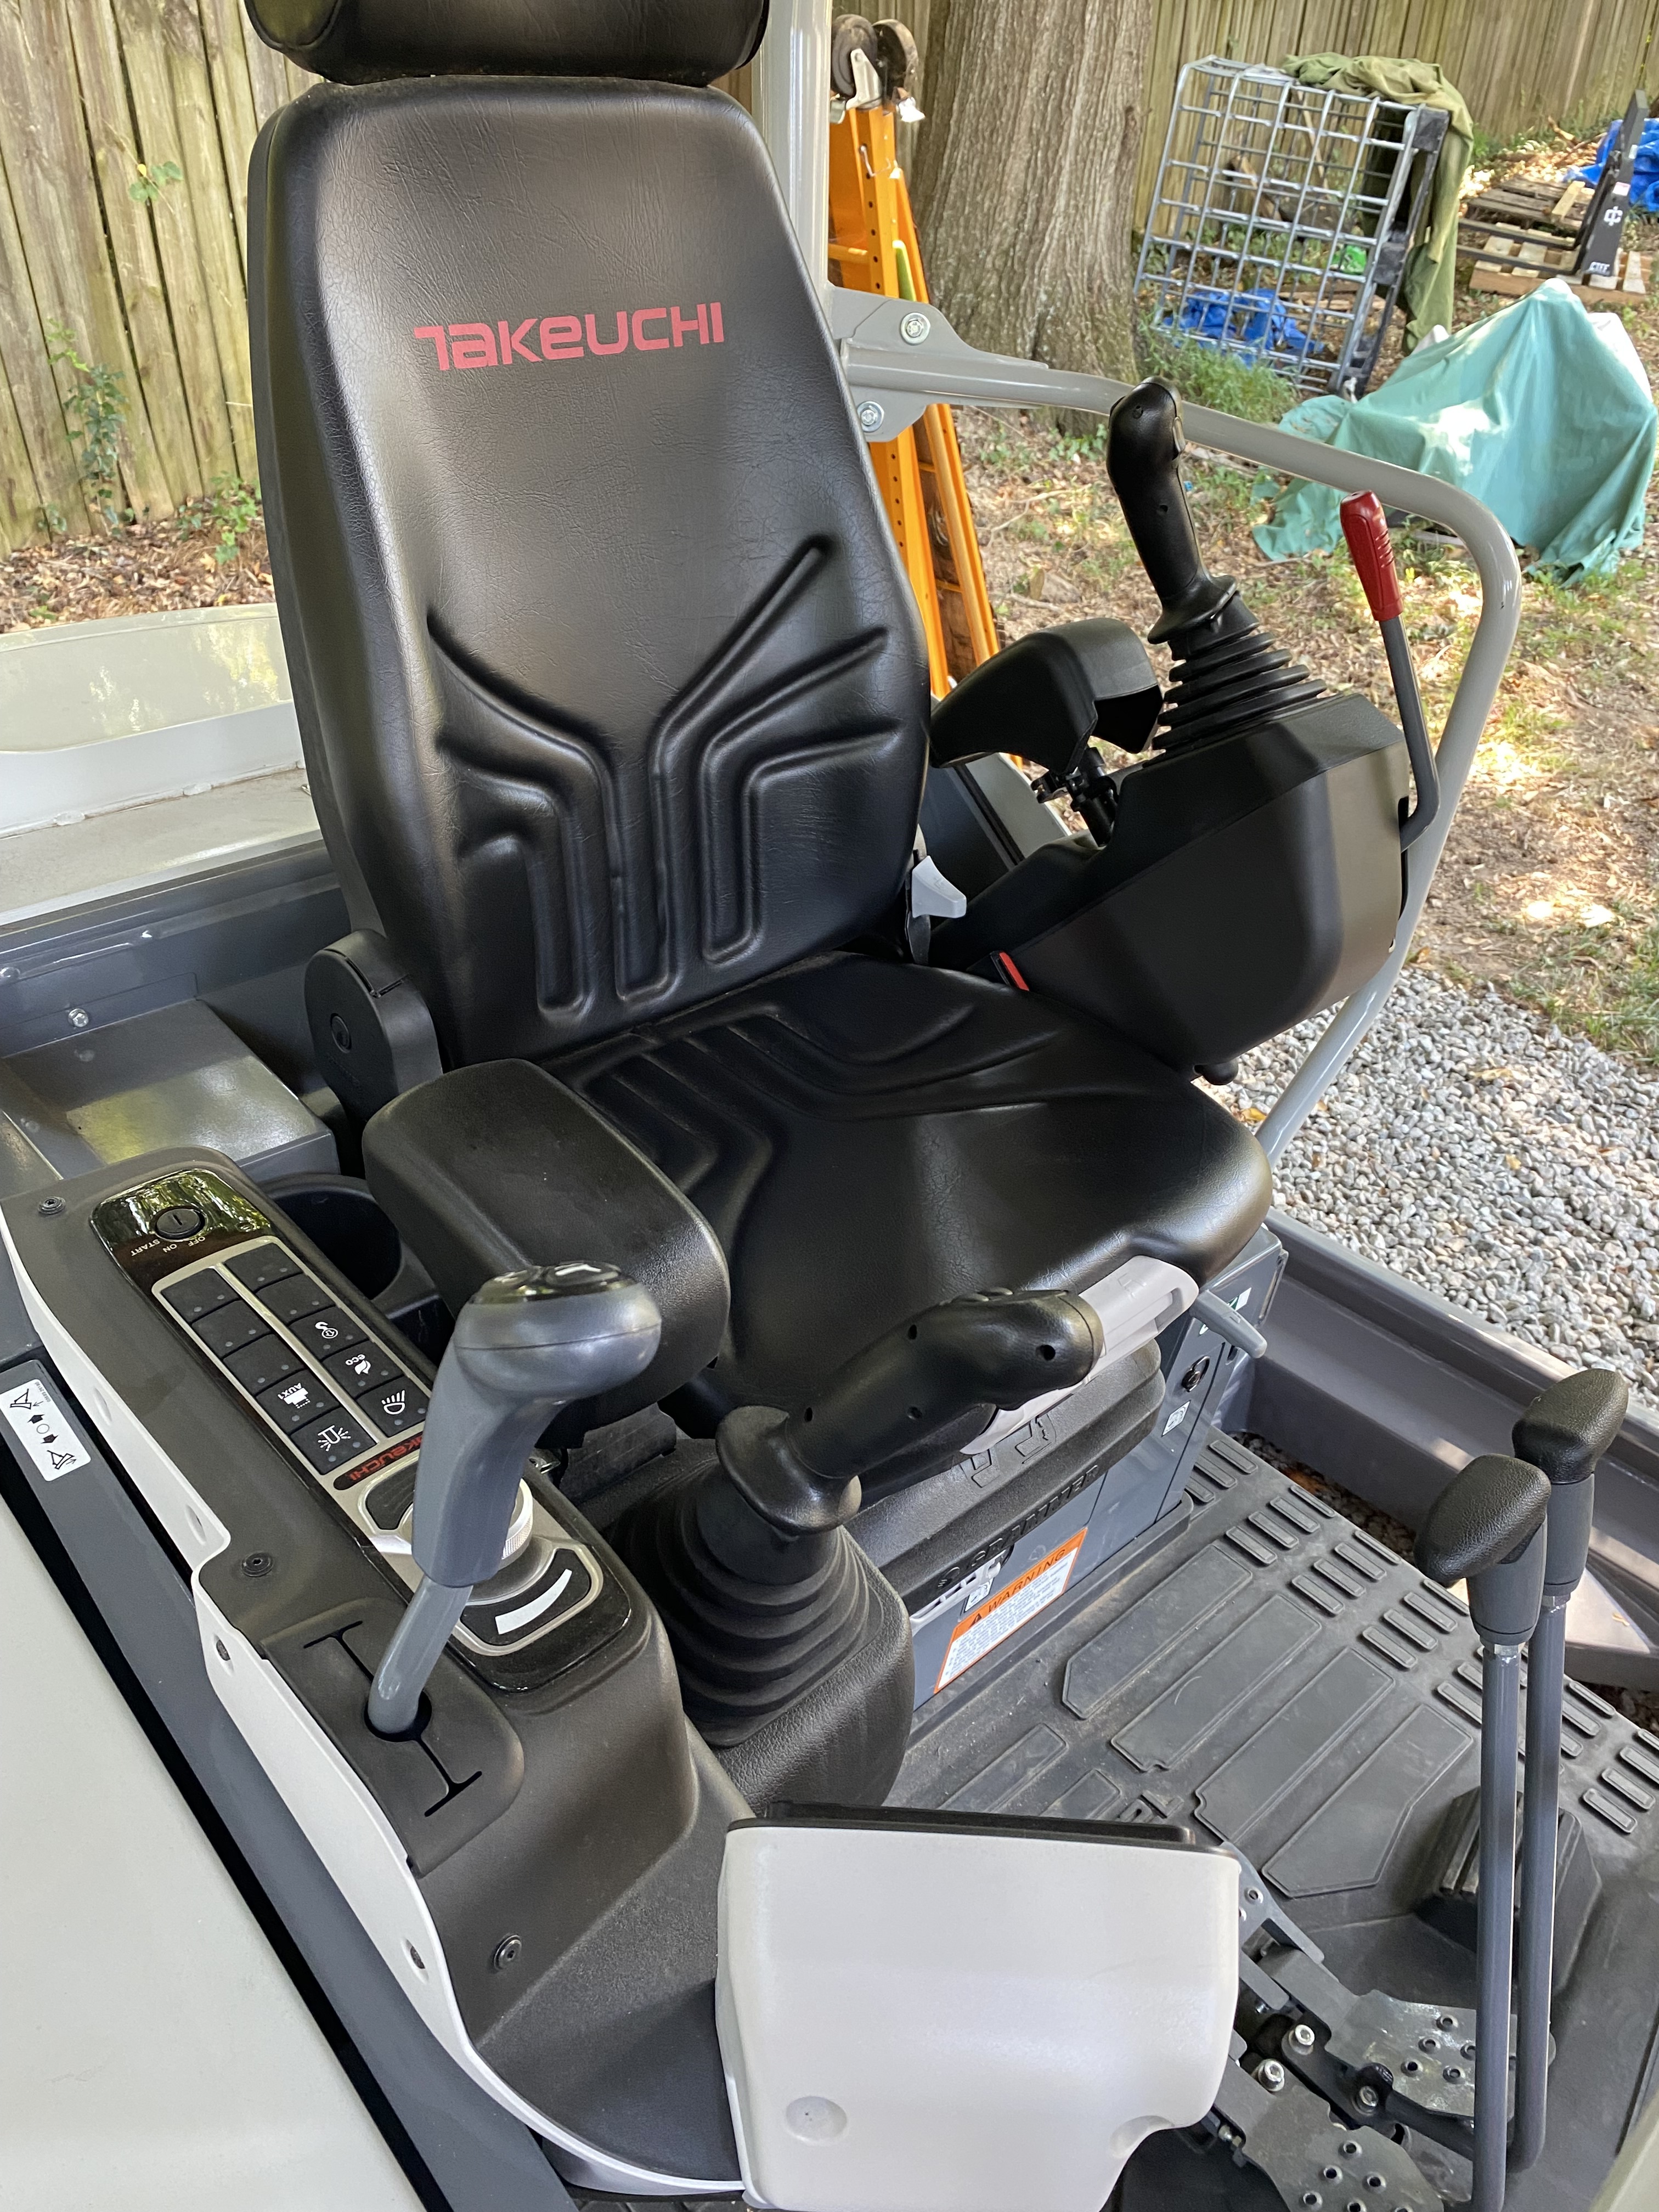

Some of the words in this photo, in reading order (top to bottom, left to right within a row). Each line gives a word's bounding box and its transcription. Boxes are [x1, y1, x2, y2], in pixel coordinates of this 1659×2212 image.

[131, 1239, 161, 1256] START
[162, 1244, 177, 1253] ON
[188, 1236, 206, 1247] OFF
[278, 1383, 302, 1400] AUX1
[989, 1549, 1065, 1613] WARNING
